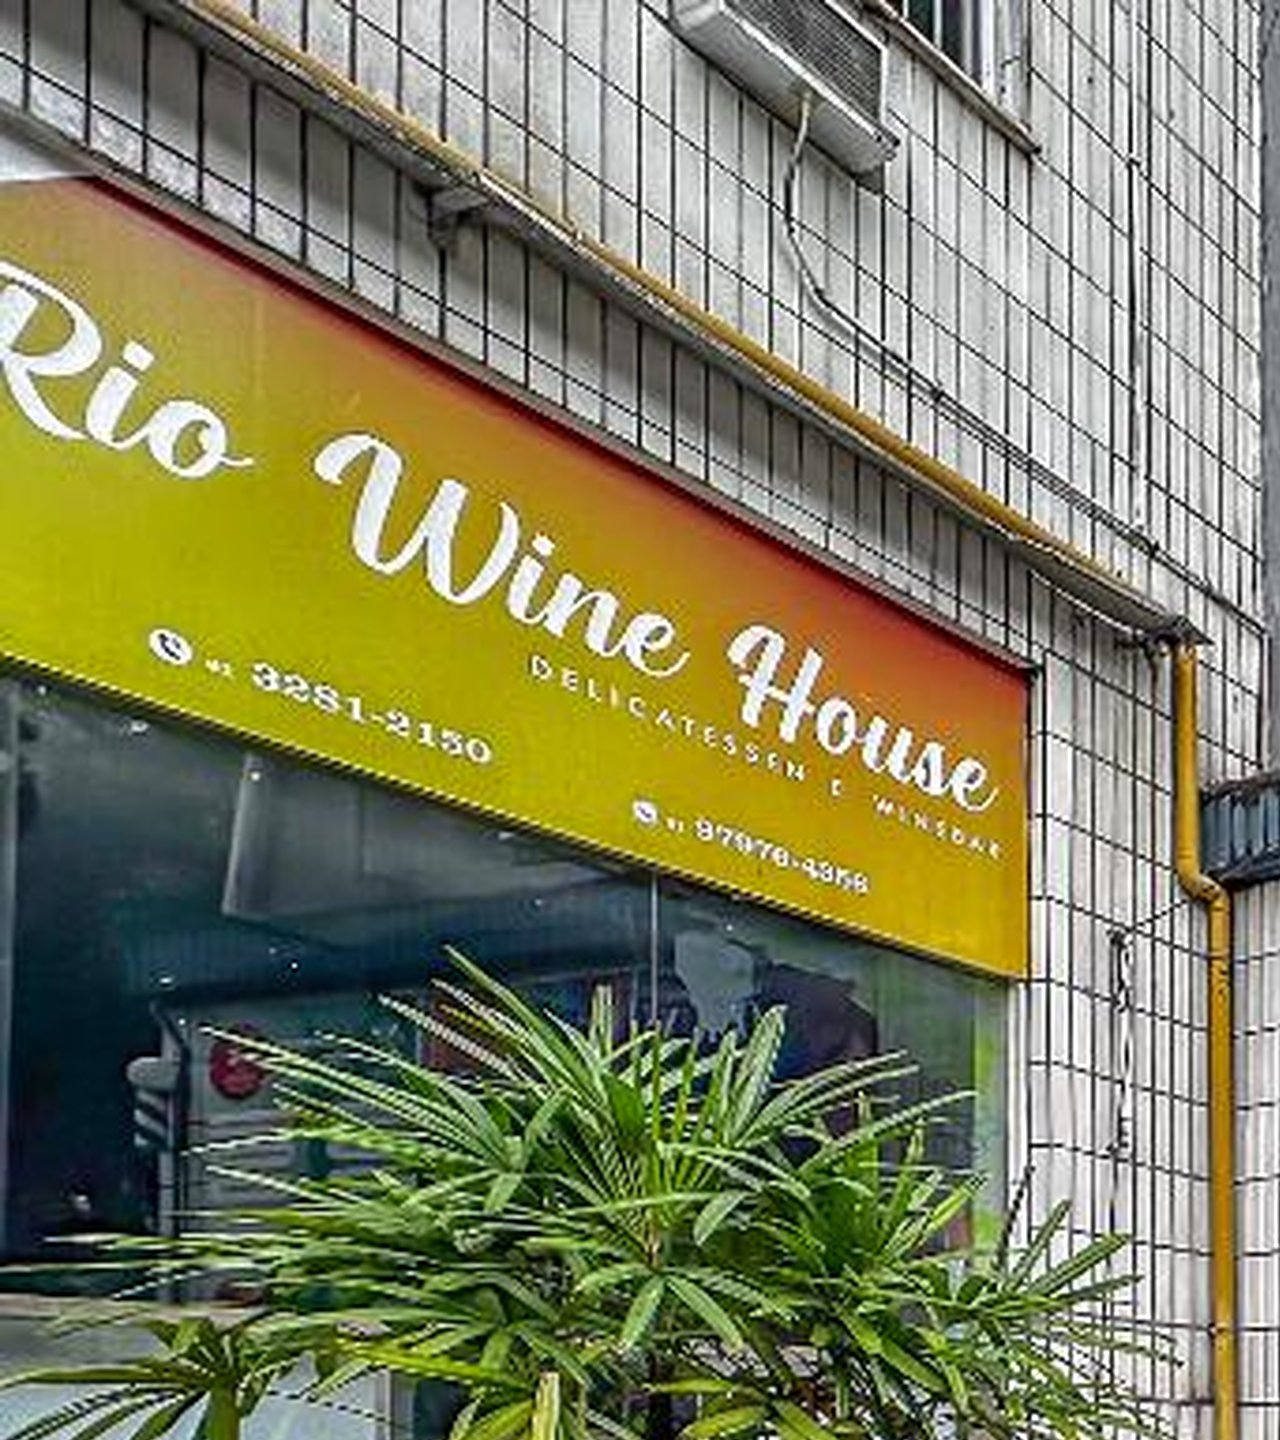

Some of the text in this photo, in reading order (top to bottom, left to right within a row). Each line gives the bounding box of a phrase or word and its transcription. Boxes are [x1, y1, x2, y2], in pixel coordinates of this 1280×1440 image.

[0, 261, 999, 812] Rio Wine House
[528, 655, 806, 782] DELICATESSEN
